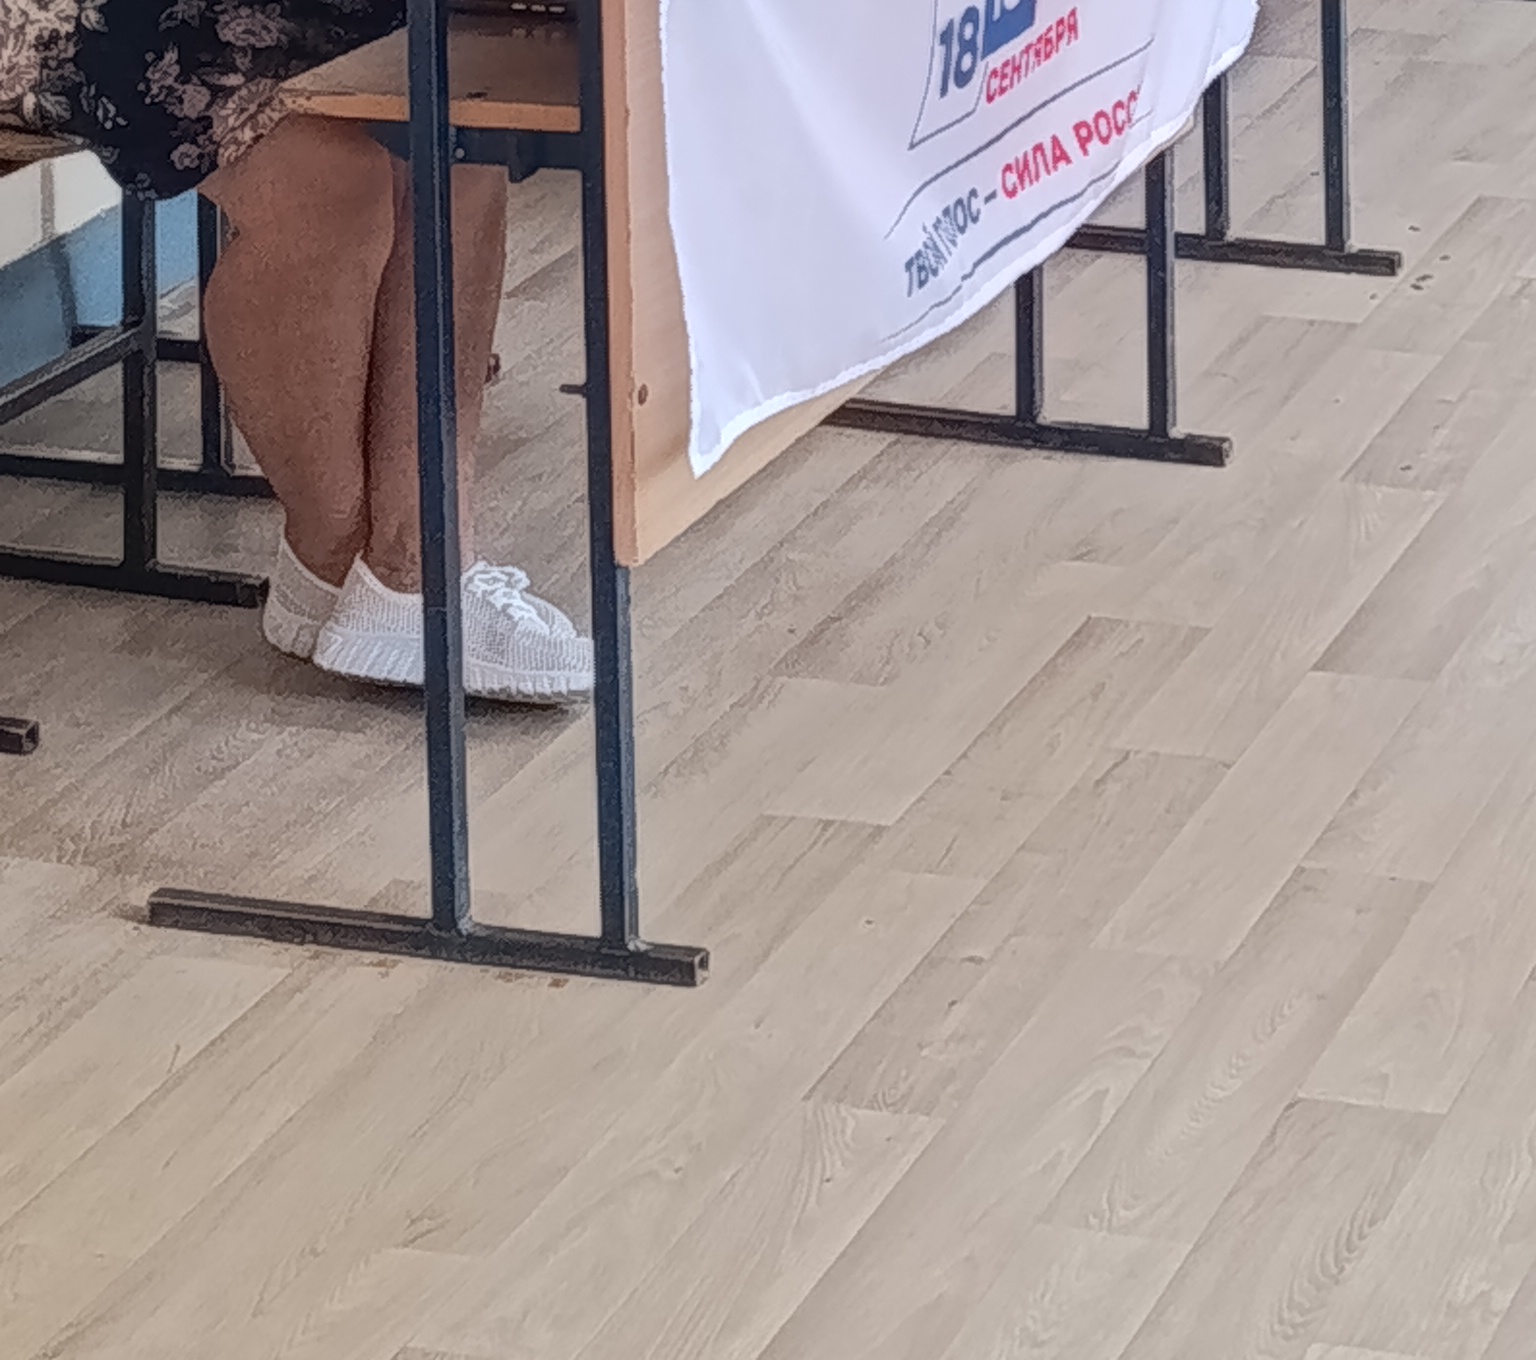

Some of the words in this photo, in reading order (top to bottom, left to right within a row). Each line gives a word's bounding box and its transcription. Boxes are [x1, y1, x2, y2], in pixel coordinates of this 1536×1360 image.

[938, 5, 981, 100] 18
[985, 6, 1080, 105] СЕНТЯБРЯ
[1001, 134, 1073, 200] СИЛА
